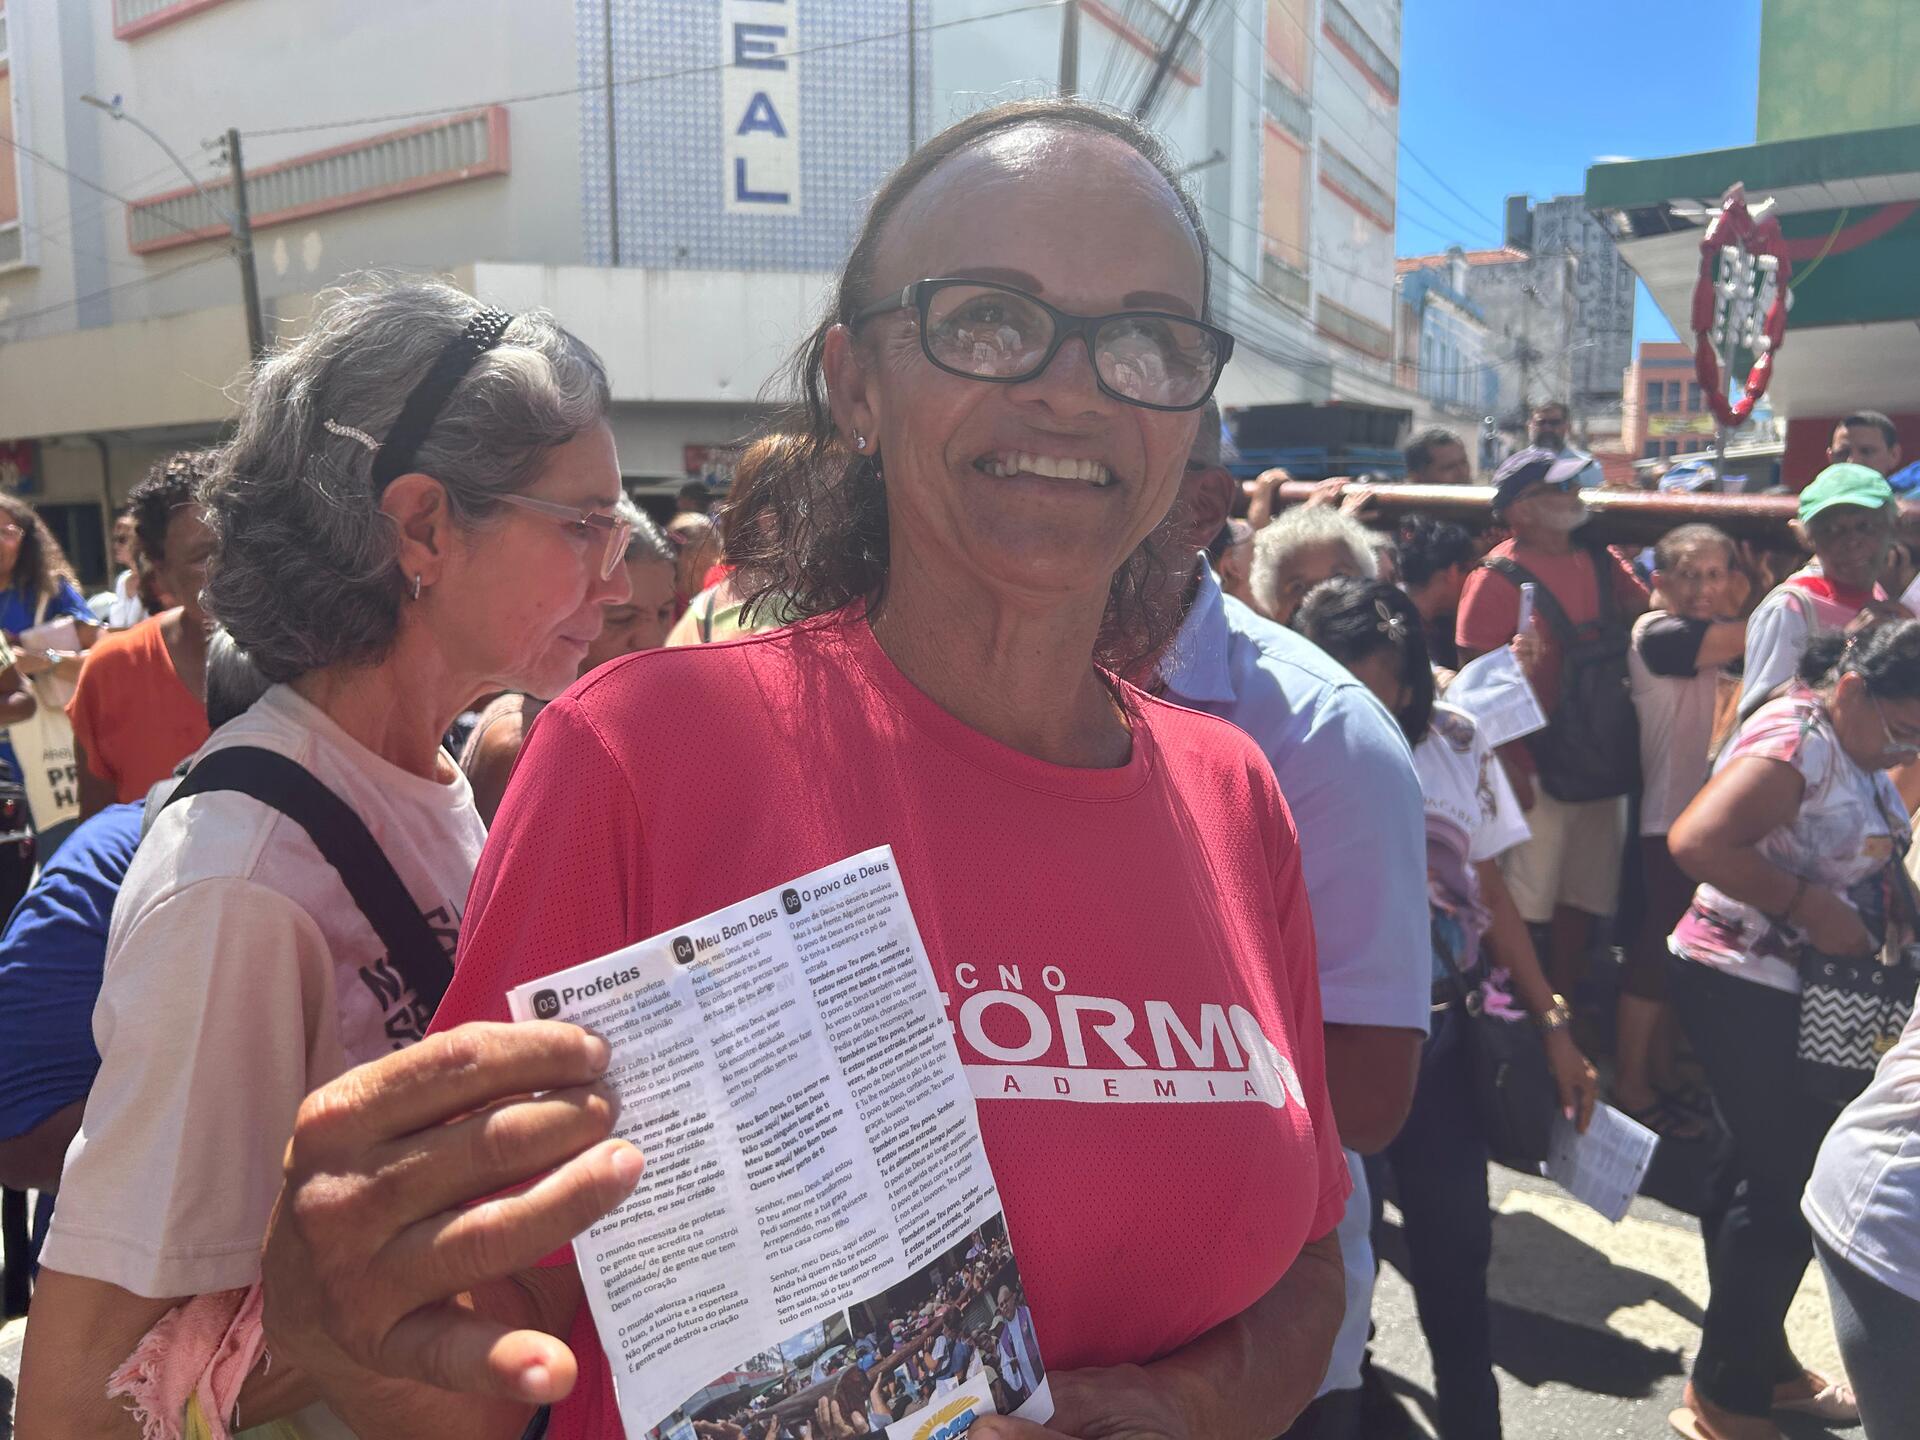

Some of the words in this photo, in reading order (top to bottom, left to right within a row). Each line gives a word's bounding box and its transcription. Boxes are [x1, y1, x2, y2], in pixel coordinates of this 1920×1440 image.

[734, 0, 790, 203] EAL
[785, 894, 799, 908] 05
[802, 890, 812, 902] O
[813, 880, 840, 901] povo
[843, 873, 857, 886] de
[858, 862, 889, 879] Deus
[678, 942, 692, 957] 04
[695, 934, 721, 952] Meu
[722, 922, 748, 940] Bom
[749, 908, 778, 928] Deus
[808, 969, 835, 985] Também
[836, 964, 848, 974] sou
[847, 958, 859, 967] Teu
[877, 940, 897, 953] Senhor
[818, 982, 835, 994] estou
[836, 974, 853, 986] nessa
[880, 949, 904, 965] somente
[955, 963, 1066, 991] CNO
[538, 996, 557, 1012] 03
[561, 966, 640, 1005] Profetas
[736, 1120, 754, 1131] Meu
[754, 1111, 769, 1123] Bom
[786, 1095, 793, 1104] O
[792, 1090, 804, 1101] teu
[804, 1080, 818, 1093] amor
[819, 1075, 830, 1085] me
[1003, 1074, 1257, 1097] ADEMIA
[742, 1145, 758, 1155] Não
[760, 1138, 772, 1147] sou
[815, 1105, 824, 1115] de
[881, 1149, 897, 1163] estou
[897, 1139, 914, 1152] nessa
[915, 1125, 936, 1142] estrada
[755, 1198, 785, 1214] Senhor,
[786, 1190, 803, 1201] meu
[822, 1170, 834, 1181] aqui
[834, 1159, 852, 1172] estou
[590, 1228, 601, 1239] Eu
[603, 1222, 618, 1232] sou
[620, 1210, 655, 1227] profeta,
[657, 1205, 669, 1213] eu
[670, 1198, 685, 1208] sou
[687, 1186, 715, 1201] cristão
[596, 1253, 604, 1263] O
[605, 1241, 635, 1258] mundo
[637, 1227, 676, 1245] necessita
[678, 1222, 690, 1231] de
[691, 1208, 725, 1227] profetas
[757, 1217, 765, 1226] O
[766, 1213, 780, 1222] teu
[782, 1203, 801, 1216] amor
[803, 1197, 815, 1206] me
[760, 1225, 777, 1237] Pedi
[779, 1211, 812, 1229] somente
[820, 1201, 832, 1212] tua
[763, 1224, 813, 1248] Arrependido,
[815, 1215, 830, 1226] mas
[831, 1208, 842, 1219] me
[841, 1192, 867, 1211] quiseste
[600, 1265, 612, 1276] De
[613, 1253, 636, 1269] gente
[638, 1247, 654, 1257] que
[657, 1234, 691, 1250] acredita
[693, 1229, 704, 1238] na
[648, 1258, 660, 1266] de
[662, 1249, 685, 1263] gente
[687, 1242, 703, 1252] que
[705, 1227, 738, 1245] constrói
[663, 1266, 674, 1274] de
[676, 1256, 699, 1271] gente
[701, 1249, 716, 1260] que
[718, 1242, 735, 1252] tem
[766, 1251, 778, 1260] em
[779, 1244, 793, 1254] tua
[794, 1236, 811, 1247] casa
[813, 1226, 834, 1239] como
[835, 1217, 849, 1229] filho
[770, 1267, 800, 1282] Senhor,
[801, 1258, 818, 1269] meu
[843, 1239, 857, 1251] aqui
[858, 1228, 876, 1242] estou
[908, 1253, 923, 1269] perto
[924, 1247, 932, 1257] da
[932, 1237, 945, 1250] terra
[773, 1280, 795, 1293] Ainda
[796, 1274, 808, 1284] há
[808, 1265, 830, 1279] quem
[832, 1258, 846, 1268] não
[847, 1253, 855, 1262] te
[856, 1233, 888, 1256] encontrou
[775, 1294, 791, 1304] Não
[828, 1274, 839, 1283] de
[839, 1264, 858, 1277] tanto
[859, 1254, 876, 1266] beco
[777, 1305, 795, 1315] Sem
[820, 1289, 830, 1298] só
[837, 1281, 850, 1290] teu
[852, 1270, 869, 1284] amor
[871, 1257, 894, 1272] renova
[611, 1297, 631, 1312] Deus
[632, 1290, 643, 1301] no
[643, 1277, 677, 1293] coração
[618, 1328, 626, 1337] O
[627, 1312, 654, 1332] mundo
[654, 1298, 686, 1314] valoriza
[695, 1283, 725, 1299] riqueza
[779, 1312, 798, 1324] tudo
[800, 1308, 811, 1317] em
[814, 1298, 836, 1310] nossa
[837, 1290, 853, 1300] vida
[622, 1340, 630, 1349] O
[630, 1330, 648, 1343] luxo,
[654, 1311, 682, 1328] luxúria
[698, 1290, 738, 1309] esperteza
[625, 1348, 641, 1360] Não
[642, 1333, 664, 1352] pensa
[665, 1327, 677, 1337] no
[677, 1316, 703, 1329] futuro
[705, 1311, 717, 1320] do
[718, 1298, 748, 1315] planeta
[635, 1352, 655, 1371] gente
[657, 1342, 671, 1354] que
[673, 1328, 701, 1345] destrói
[710, 1314, 739, 1329] criação
